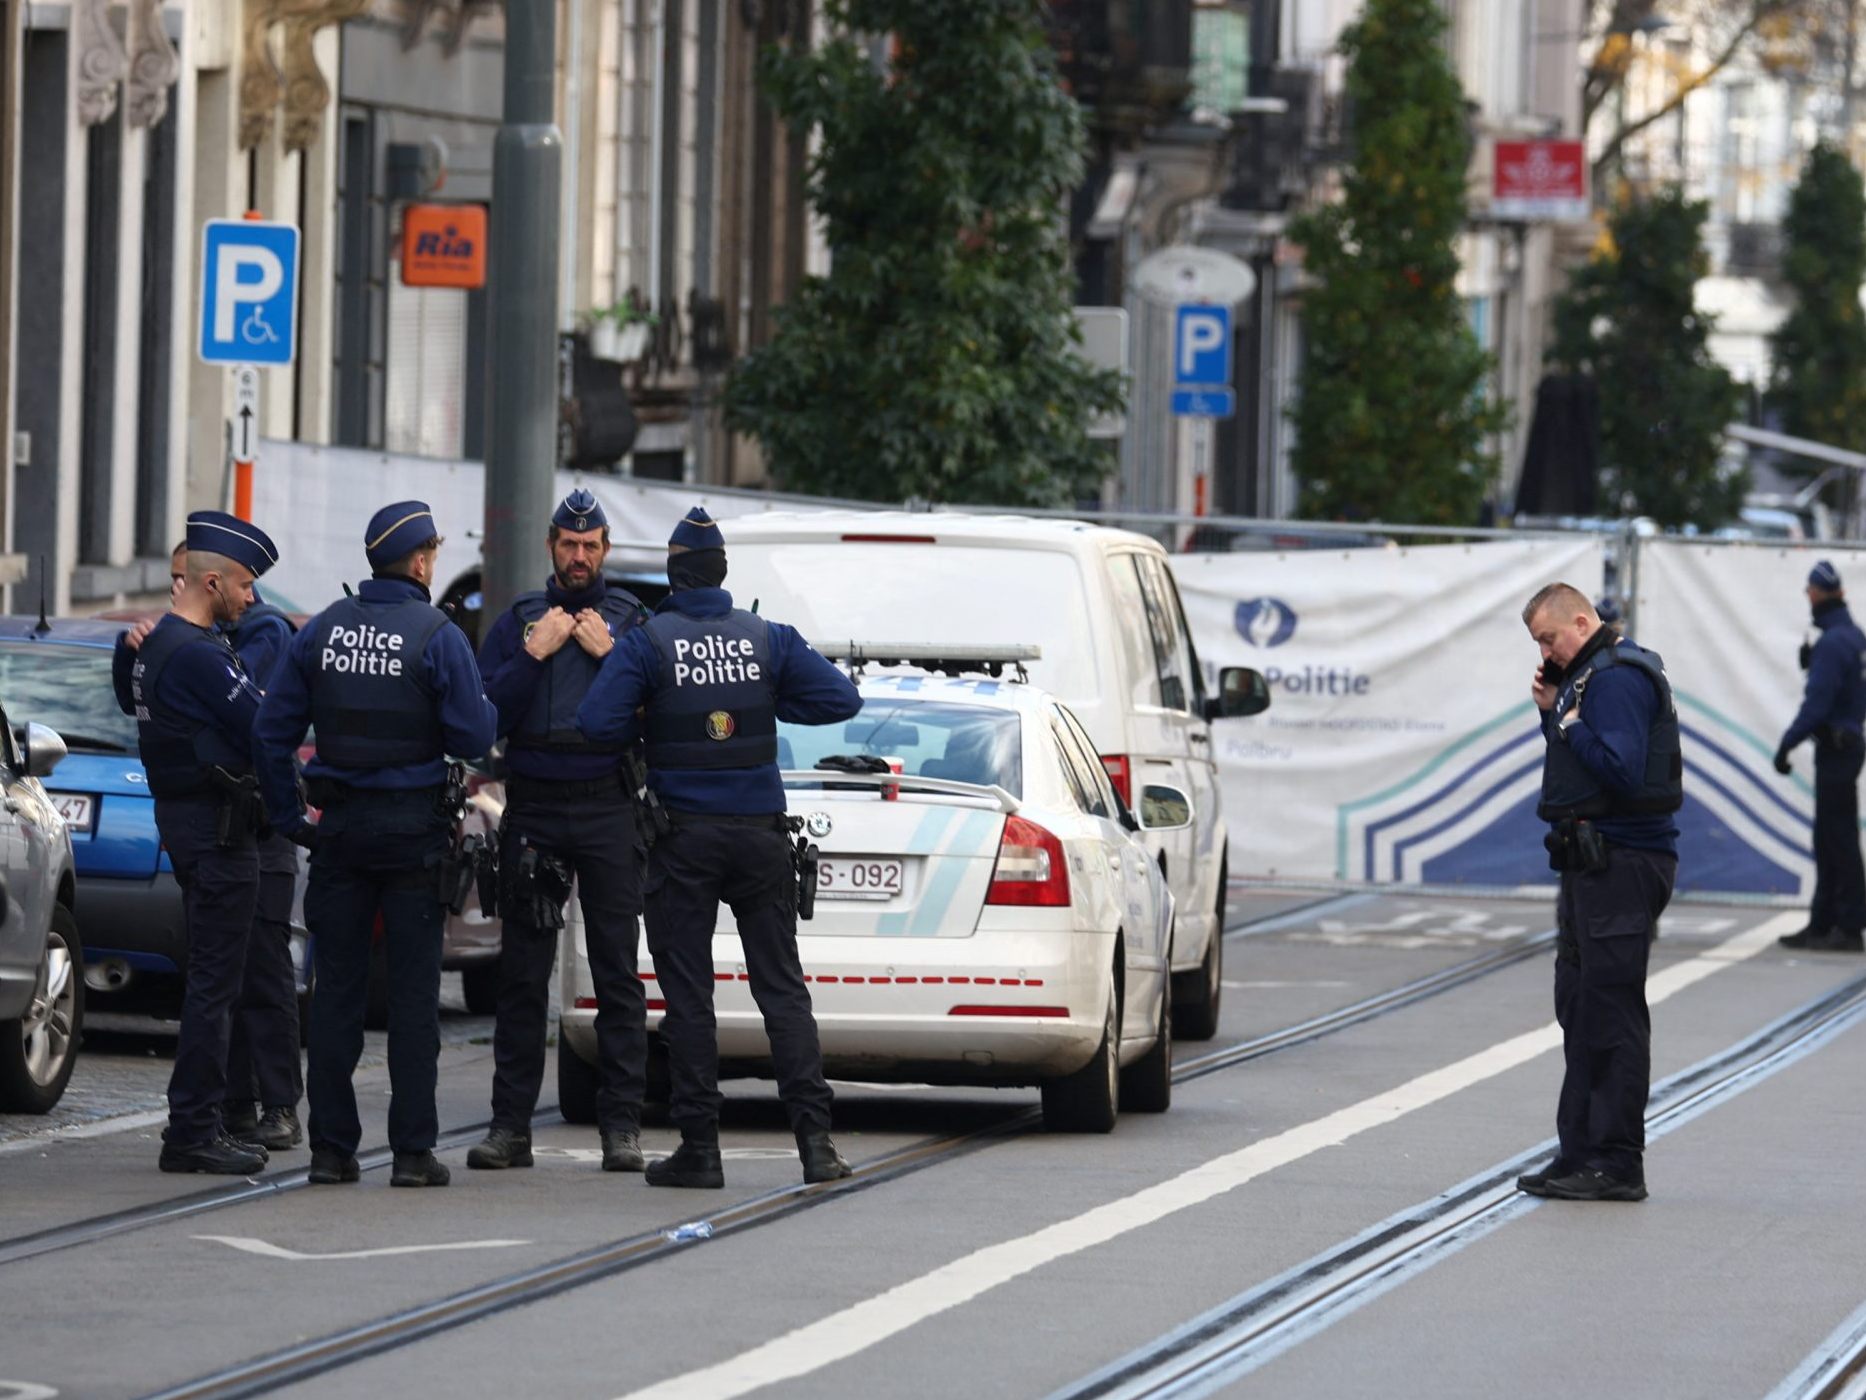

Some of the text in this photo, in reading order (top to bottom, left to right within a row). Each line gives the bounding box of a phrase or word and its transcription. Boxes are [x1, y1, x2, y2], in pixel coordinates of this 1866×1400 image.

[415, 223, 473, 257] Ria
[213, 243, 284, 343] P
[1180, 314, 1225, 376] P
[327, 624, 404, 651] Police
[674, 634, 754, 661] Police
[321, 647, 403, 677] Politie
[674, 656, 760, 687] Politie
[1265, 663, 1370, 696] Politie
